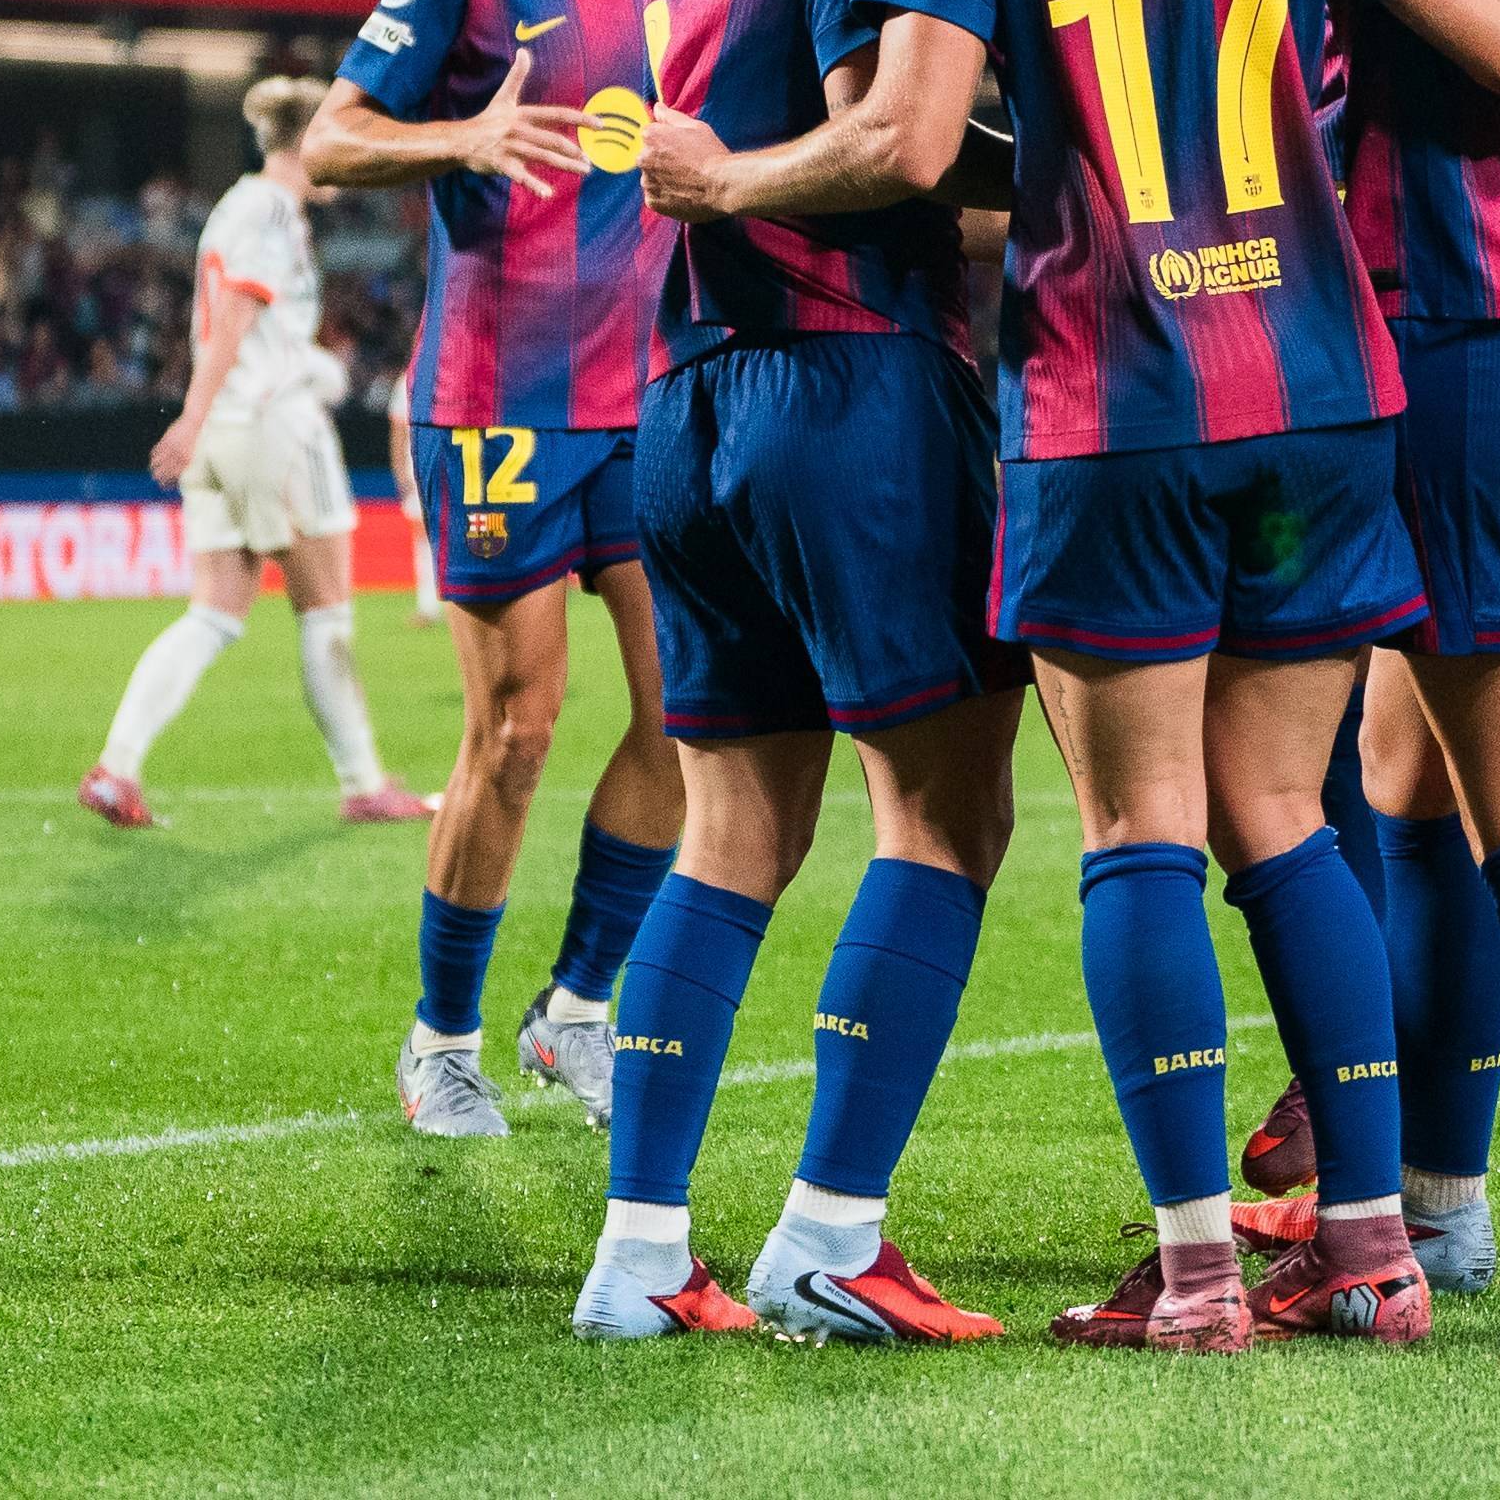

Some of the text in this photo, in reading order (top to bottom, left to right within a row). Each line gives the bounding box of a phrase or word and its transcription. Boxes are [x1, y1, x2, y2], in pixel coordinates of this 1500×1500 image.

[1197, 236, 1279, 269] UNHCR
[1203, 257, 1281, 288] ACNUR
[451, 426, 537, 505] 12
[1154, 1047, 1225, 1075] BARÇA
